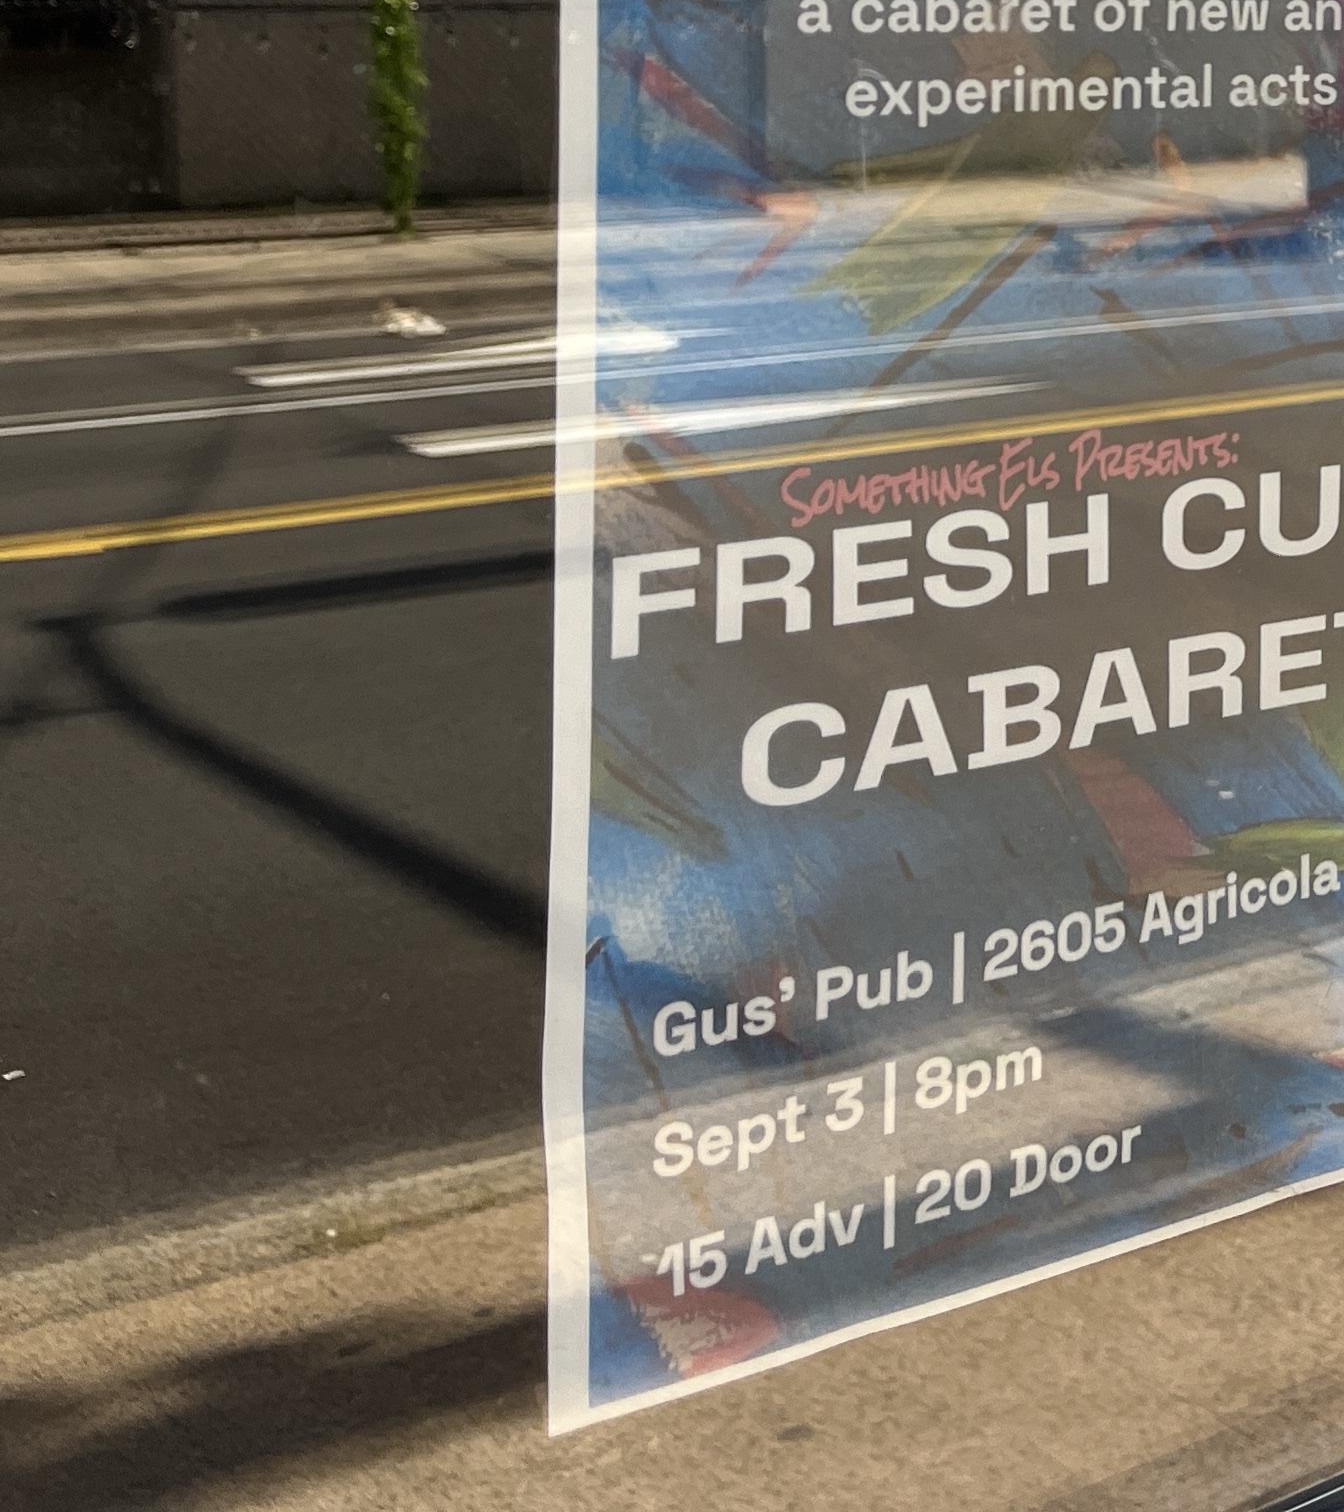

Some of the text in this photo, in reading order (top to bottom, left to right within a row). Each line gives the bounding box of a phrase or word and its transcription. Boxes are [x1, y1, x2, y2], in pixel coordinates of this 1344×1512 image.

[845, 63, 1338, 127] experimental acts
[609, 493, 1111, 660] FRESH
[652, 853, 1341, 1056] Gus' Pub 2605 Agricola
[653, 1038, 1044, 1180] Sept 3 8pm
[744, 1120, 1142, 1275] Adv 20 Door
